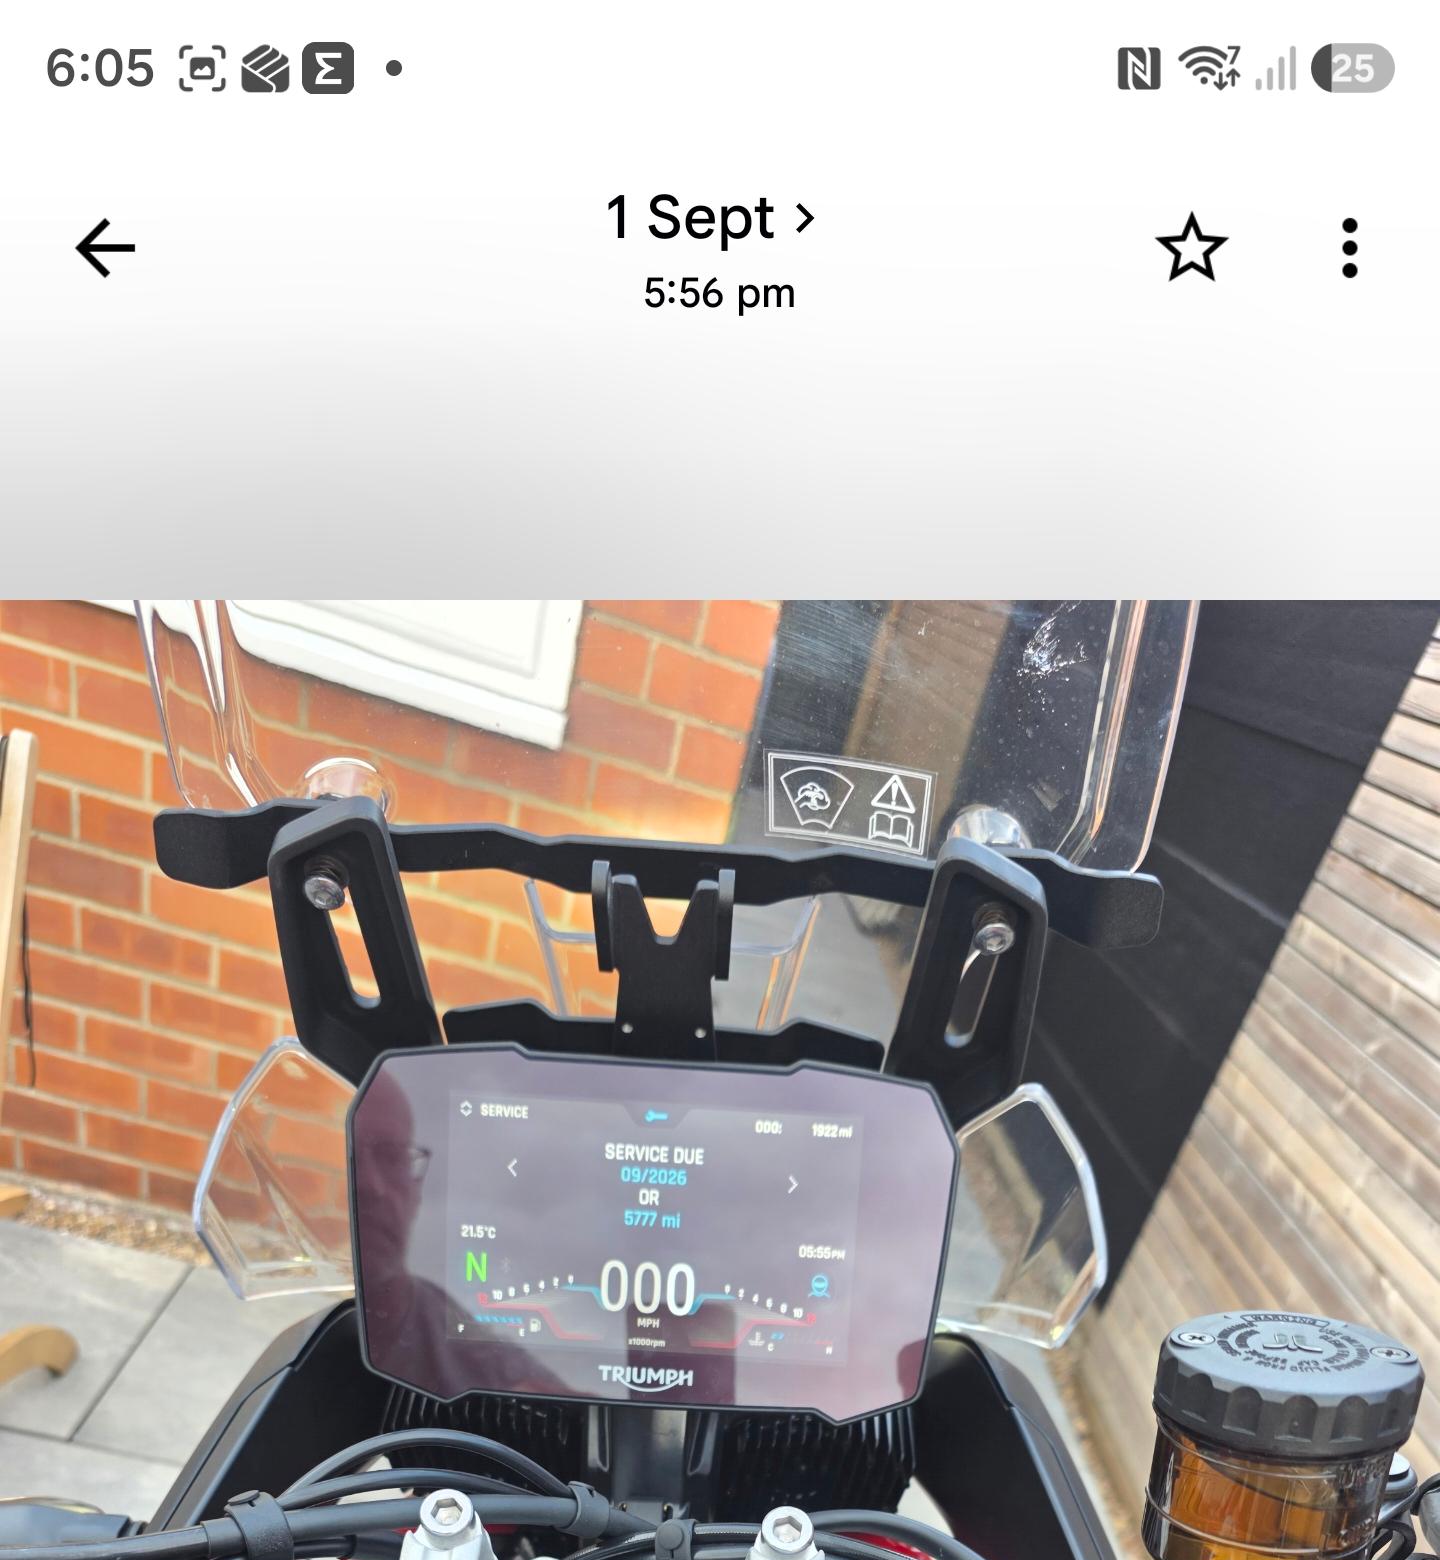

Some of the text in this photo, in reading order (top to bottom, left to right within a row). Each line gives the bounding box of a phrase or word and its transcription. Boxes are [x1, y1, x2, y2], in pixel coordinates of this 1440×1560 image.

[480, 1102, 529, 1119] SERVICE
[604, 1142, 705, 1165] SERVICE DUE
[620, 1166, 687, 1186] 09/2026
[638, 1188, 660, 1206] OR
[624, 1209, 681, 1229] 5777 mi
[465, 1251, 488, 1283] N
[600, 1259, 696, 1317] 000
[636, 1317, 661, 1329] MPH
[598, 1365, 694, 1392] TRIUMPH
